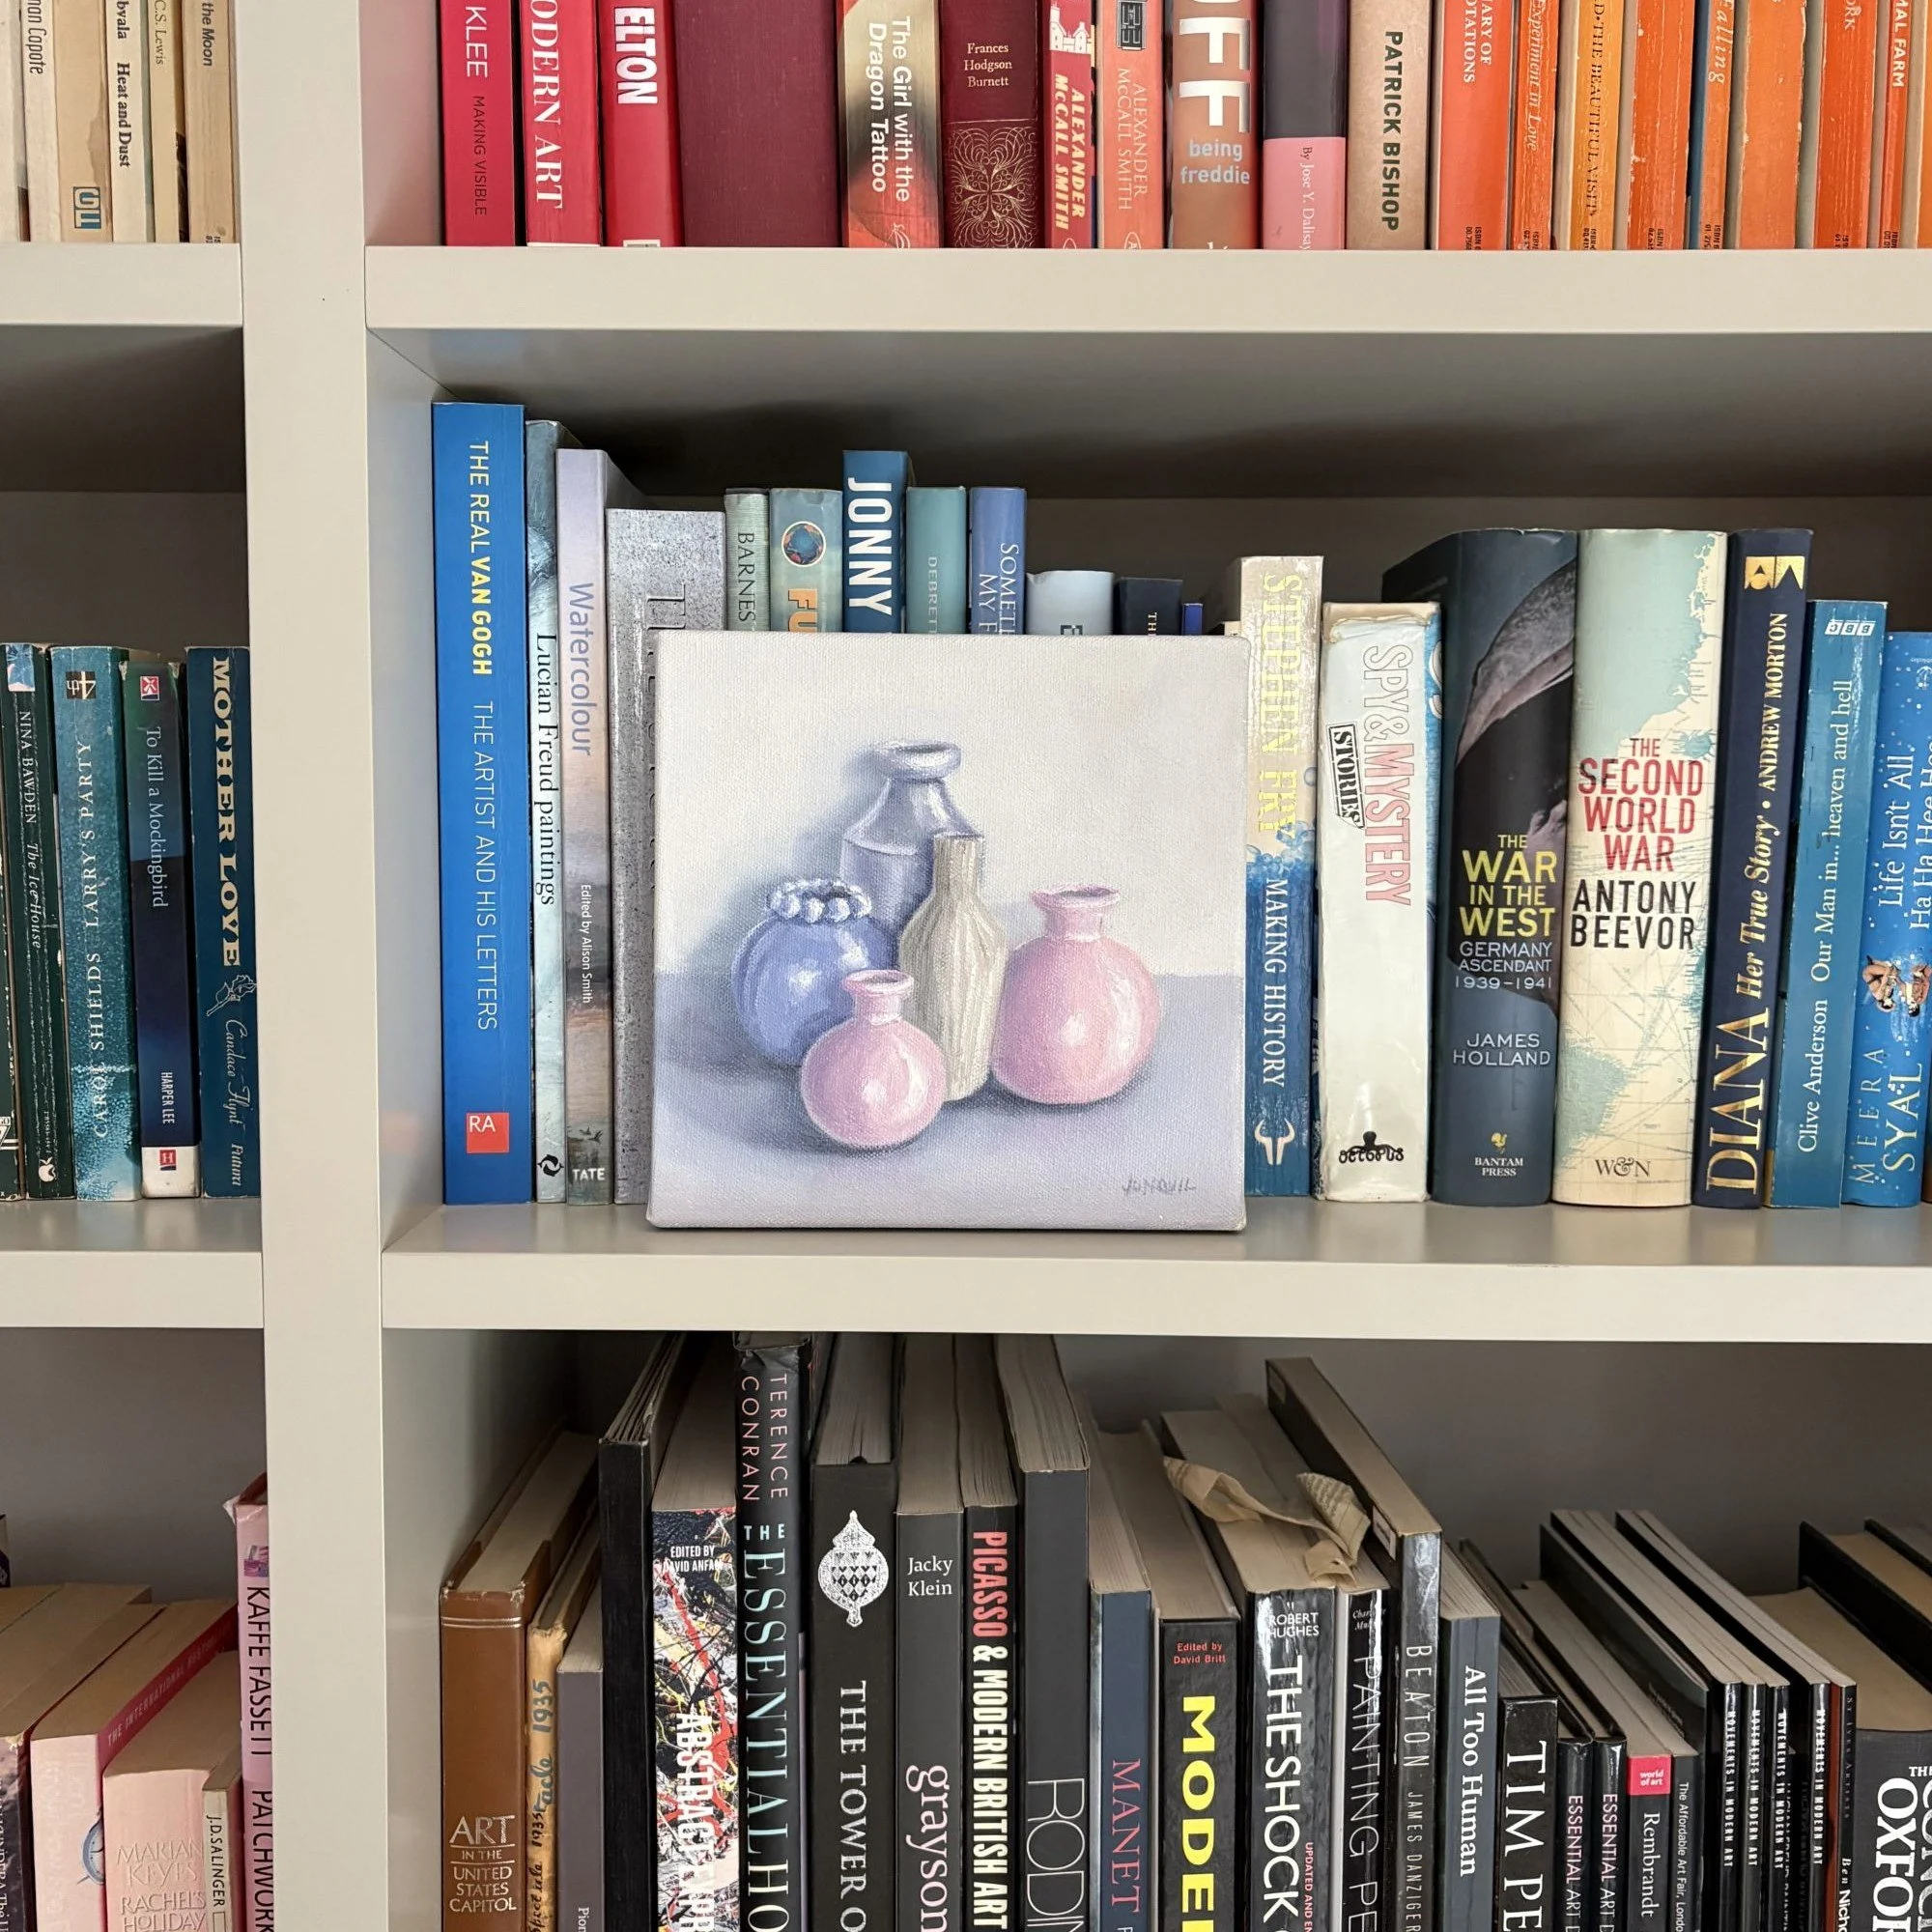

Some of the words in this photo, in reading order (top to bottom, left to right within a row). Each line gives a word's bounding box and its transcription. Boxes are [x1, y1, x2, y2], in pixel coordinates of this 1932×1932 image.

[201, 2, 213, 25] the
[25, 27, 46, 74] Capote
[155, 29, 167, 65] Lewis
[202, 29, 214, 67] Moon
[465, 6, 488, 78] KLEE
[613, 7, 659, 104] ELTON
[892, 15, 911, 59] The
[967, 43, 1009, 54] Frances
[1481, 42, 1492, 65] OF
[116, 63, 130, 99] Heat
[866, 22, 887, 111] Dragon
[964, 58, 1013, 72] Hodgson
[967, 75, 1009, 88] Burnett
[1383, 31, 1404, 134] PATRICK
[1891, 38, 1907, 88] FARM
[893, 66, 913, 107] Girl
[1528, 90, 1541, 107] in
[117, 100, 131, 129] and
[472, 96, 487, 156] MAKING
[1527, 110, 1542, 151] Love
[1588, 64, 1603, 162] BEAUTIFUL
[118, 131, 132, 167] Dust
[870, 118, 889, 193] Tattoo
[894, 114, 914, 160] with
[1071, 88, 1086, 218] ALEXANDER
[1133, 82, 1149, 198] ALEXANDER
[1189, 139, 1243, 161] being
[1301, 147, 1313, 160] By
[474, 158, 487, 215] VISIBLE
[535, 134, 563, 210] ART
[895, 165, 915, 202] the
[1118, 147, 1132, 211] SMITH
[1180, 165, 1251, 185] freddie
[1382, 142, 1402, 231] BISHOP
[1055, 162, 1069, 231] SMITH
[1303, 191, 1315, 204] Y.
[469, 440, 489, 487] THE
[469, 494, 491, 554] REAL
[847, 477, 894, 616] JONNY
[470, 556, 492, 605] VAN
[979, 573, 998, 611] MY
[471, 611, 494, 675] GOGH
[1260, 573, 1303, 755] STEPHEN
[536, 632, 558, 715] Lucian
[569, 582, 598, 755] Watercolour
[1833, 679, 1853, 717] hell
[18, 711, 32, 751] NINA
[146, 726, 161, 748] To
[473, 700, 494, 745] THE
[1831, 721, 1851, 760] and
[147, 752, 164, 783] Kill
[213, 656, 236, 843] MOTHER
[538, 724, 559, 792] Freud
[1630, 737, 1662, 757] THE
[21, 757, 37, 824] BAWDEN
[76, 740, 95, 820] PARTY
[473, 751, 495, 829] ARTIST
[1577, 757, 1704, 797] SECOND
[1258, 769, 1297, 840] FRY
[1582, 796, 1696, 834] WORLD
[26, 843, 39, 869] The
[147, 803, 169, 908] Mockingbird
[475, 835, 497, 884] AND
[534, 800, 561, 906] paintings
[1462, 849, 1558, 883] WAR
[1604, 834, 1675, 872] WAR
[219, 853, 241, 967] LOVE
[475, 891, 497, 927] HIS
[1469, 885, 1494, 906] IN
[1506, 884, 1546, 906] THE
[1572, 878, 1696, 915] ANTONY
[1706, 1008, 1770, 1195] DIANA
[1763, 613, 1789, 698] MORTON
[1814, 887, 1836, 936] Man
[1264, 878, 1289, 973] MAKING
[1460, 906, 1555, 937] WEST
[1570, 914, 1694, 950] BEEVOR
[1459, 941, 1552, 957] GERMANY
[1811, 943, 1833, 983] Our
[87, 952, 105, 1052] SHIELDS
[477, 935, 497, 1030] LETTERS
[1263, 984, 1287, 1089] HISTORY
[1453, 1050, 1551, 1066] HOLLAND
[1466, 1034, 1541, 1048] JAMES
[1803, 998, 1828, 1096] Anderson
[91, 1060, 109, 1140] CAROL
[160, 1071, 174, 1107] HARPER
[162, 1108, 176, 1125] LEE
[469, 1115, 497, 1133] RA
[1798, 1100, 1820, 1153] Clive
[1474, 1156, 1524, 1168] BANTAM
[1481, 1167, 1518, 1178] PRESS
[741, 1376, 760, 1501] CONRAN
[770, 1374, 788, 1499] TERENCE
[670, 1546, 701, 1557] EDITED
[703, 1545, 715, 1556] BY
[744, 1523, 785, 1541] THE
[908, 1556, 953, 1576] Jacky
[908, 1580, 952, 1596] Klein
[973, 1531, 1008, 1637] PICASSO
[246, 1586, 270, 1657] KAFFE
[1268, 1625, 1320, 1638] HUGHES
[1269, 1612, 1319, 1626] ROBERT
[973, 1644, 1008, 1662] &
[1174, 1656, 1201, 1664] David
[1177, 1643, 1208, 1652] Edited
[744, 1548, 788, 1855] ESSENTIAL
[1265, 1655, 1303, 1747] THE
[1403, 1645, 1433, 1767] BEATON
[1463, 1664, 1488, 1707] All
[840, 1681, 867, 1754] THE
[973, 1669, 1008, 1770] MODERN
[1463, 1713, 1485, 1767] Too
[1639, 1770, 1664, 1778] world
[1679, 1782, 1689, 1801] The
[1725, 1780, 1735, 1793] IN
[1406, 1792, 1423, 1843] JAMES
[1504, 1740, 1548, 1858] TIM
[1724, 1798, 1735, 1842] MODERN
[449, 1815, 515, 1844] ART
[840, 1764, 867, 1900] TOWER
[973, 1777, 1008, 1874] BRITISH
[1112, 1758, 1141, 1913] MANET
[1263, 1755, 1302, 1924] SHOCK
[1460, 1775, 1483, 1878] Human
[1566, 1795, 1583, 1885] ESSENTIAL
[1601, 1794, 1618, 1883] ESSENTIAL
[1677, 1803, 1689, 1856] Affordable
[117, 1839, 204, 1864] MARIAN
[453, 1865, 513, 1881] UNITED
[462, 1851, 474, 1860] IN
[477, 1850, 502, 1860] THE
[1304, 1842, 1314, 1890] UPDATED
[1640, 1812, 1661, 1918] Rembrandt
[1677, 1858, 1688, 1875] Art
[1723, 1847, 1733, 1867] ART
[449, 1898, 517, 1913] CAPITOL
[456, 1883, 509, 1896] STATES
[973, 1882, 1008, 1930] ART
[1565, 1889, 1581, 1918] ART
[1600, 1888, 1615, 1918] ART
